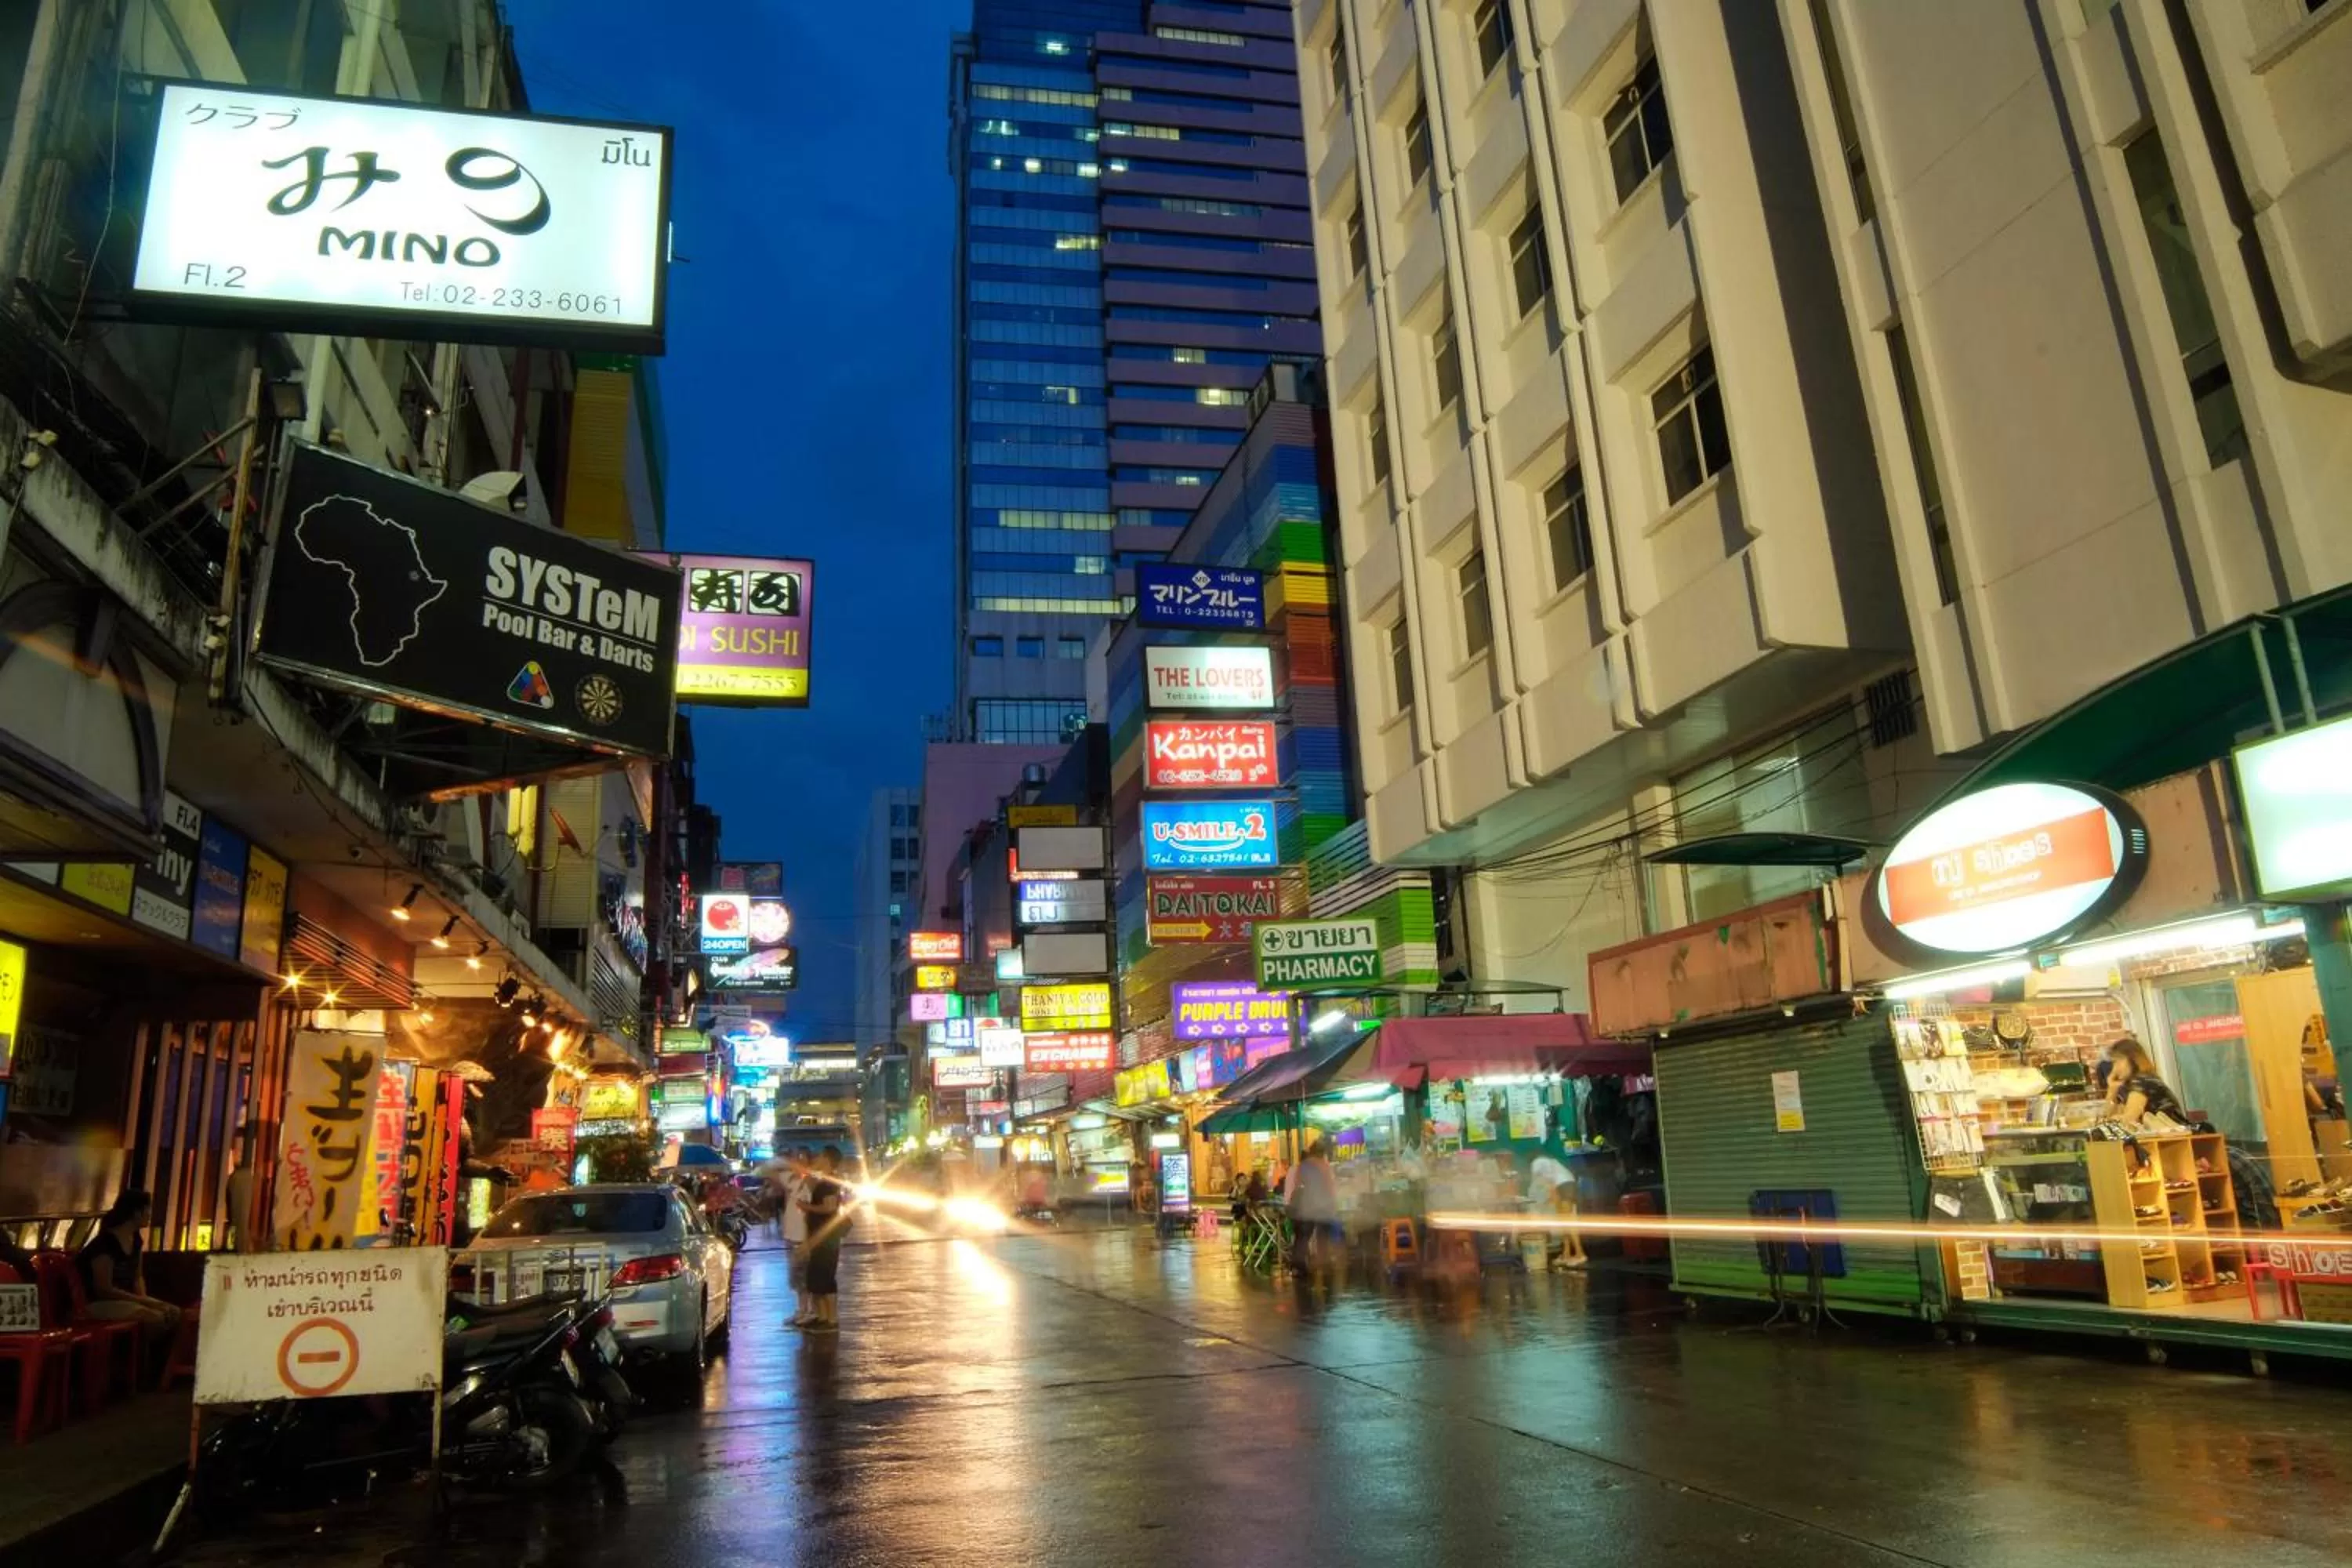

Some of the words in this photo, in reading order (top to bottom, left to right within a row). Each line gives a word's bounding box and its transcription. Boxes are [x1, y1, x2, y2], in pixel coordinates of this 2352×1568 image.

[186, 102, 301, 132] クラブ
[601, 136, 652, 168] มิโน
[318, 225, 502, 269] MINO
[482, 603, 534, 639] Pool
[537, 618, 578, 651] Bar
[579, 634, 597, 657] &
[599, 636, 654, 673] Darts
[710, 626, 800, 657] SUSHI
[1154, 667, 1189, 688] THE
[1196, 667, 1264, 688] LOVERS
[1178, 726, 1236, 741] カンパイ
[1153, 731, 1267, 769] Kanpai
[1155, 892, 1277, 918] DAITOKAI
[1286, 926, 1370, 949] ขายยา
[1263, 954, 1374, 982] PHARMACY
[1023, 993, 1074, 1007] THANIYA
[1078, 991, 1108, 1004] GOLD
[1179, 1001, 1245, 1023] PURPLE
